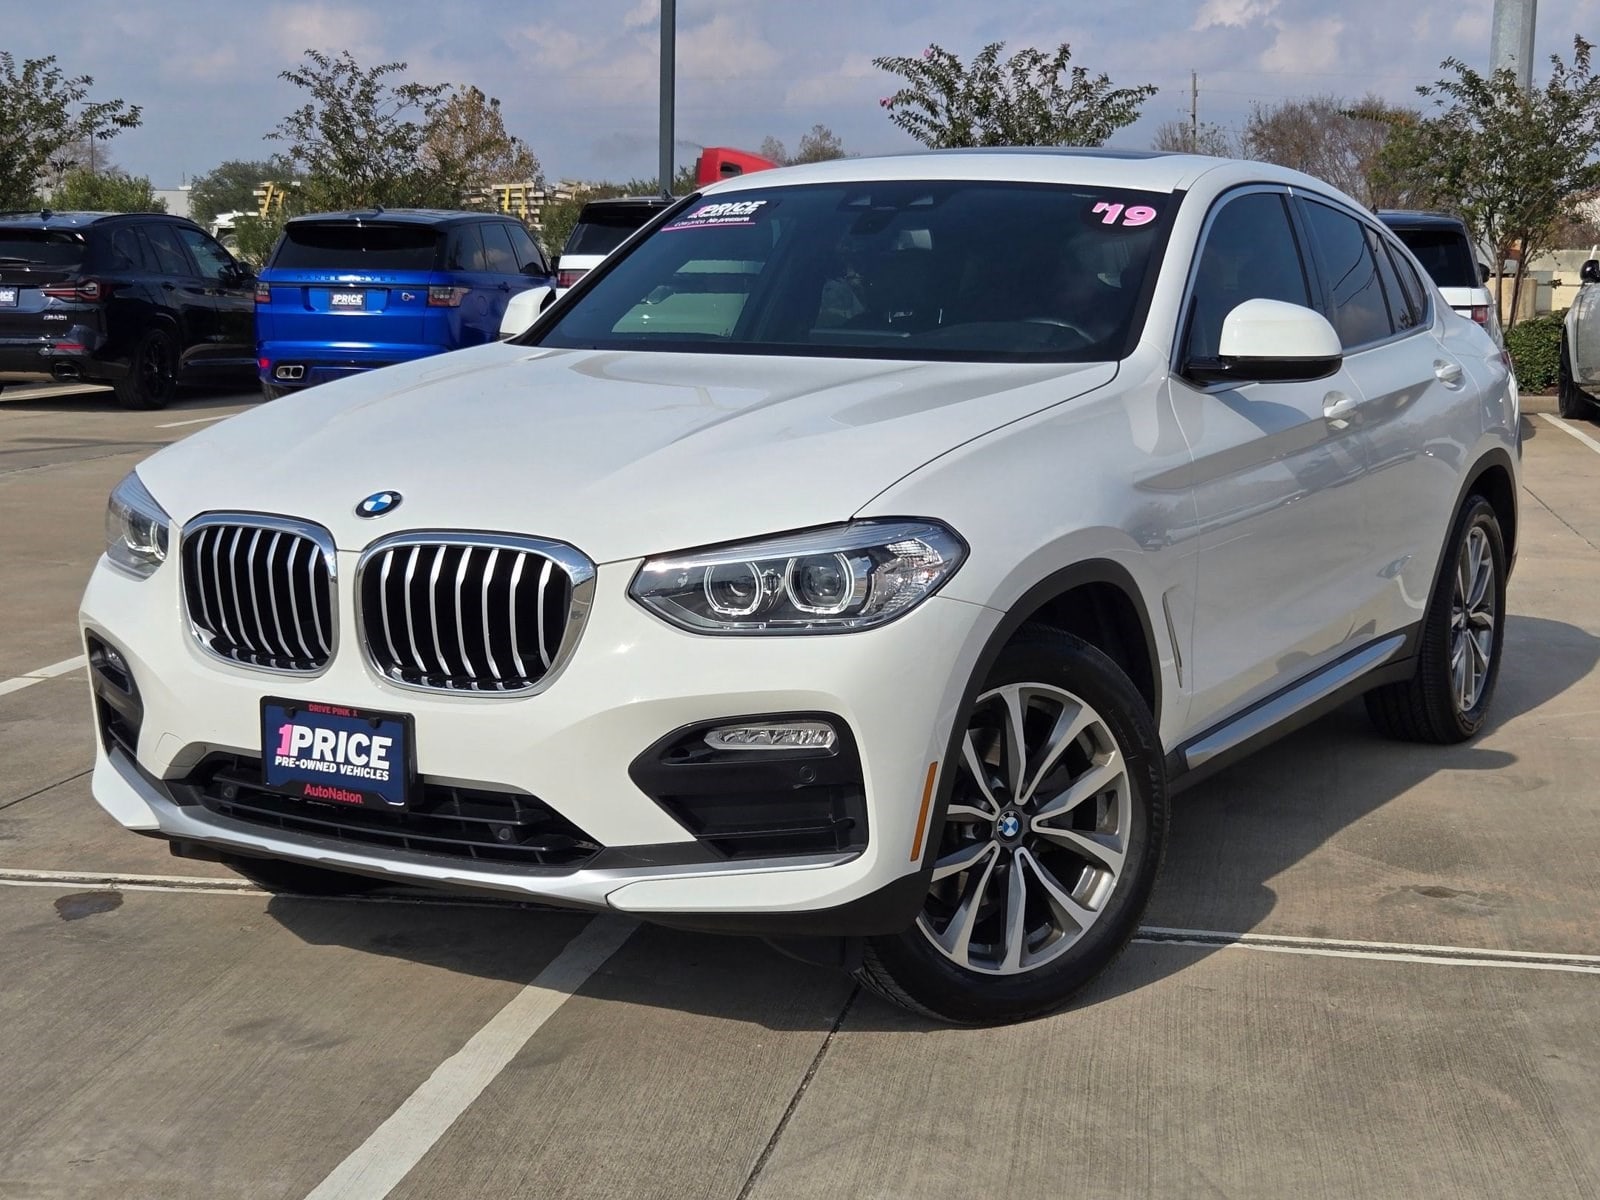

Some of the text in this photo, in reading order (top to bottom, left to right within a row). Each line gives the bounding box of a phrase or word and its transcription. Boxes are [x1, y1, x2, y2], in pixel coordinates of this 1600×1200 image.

[308, 704, 332, 715] DRIVE
[276, 723, 393, 770] 1PRICE
[274, 756, 390, 781] PRE-OWNED VEHICLES
[304, 784, 363, 804] AutoNation
